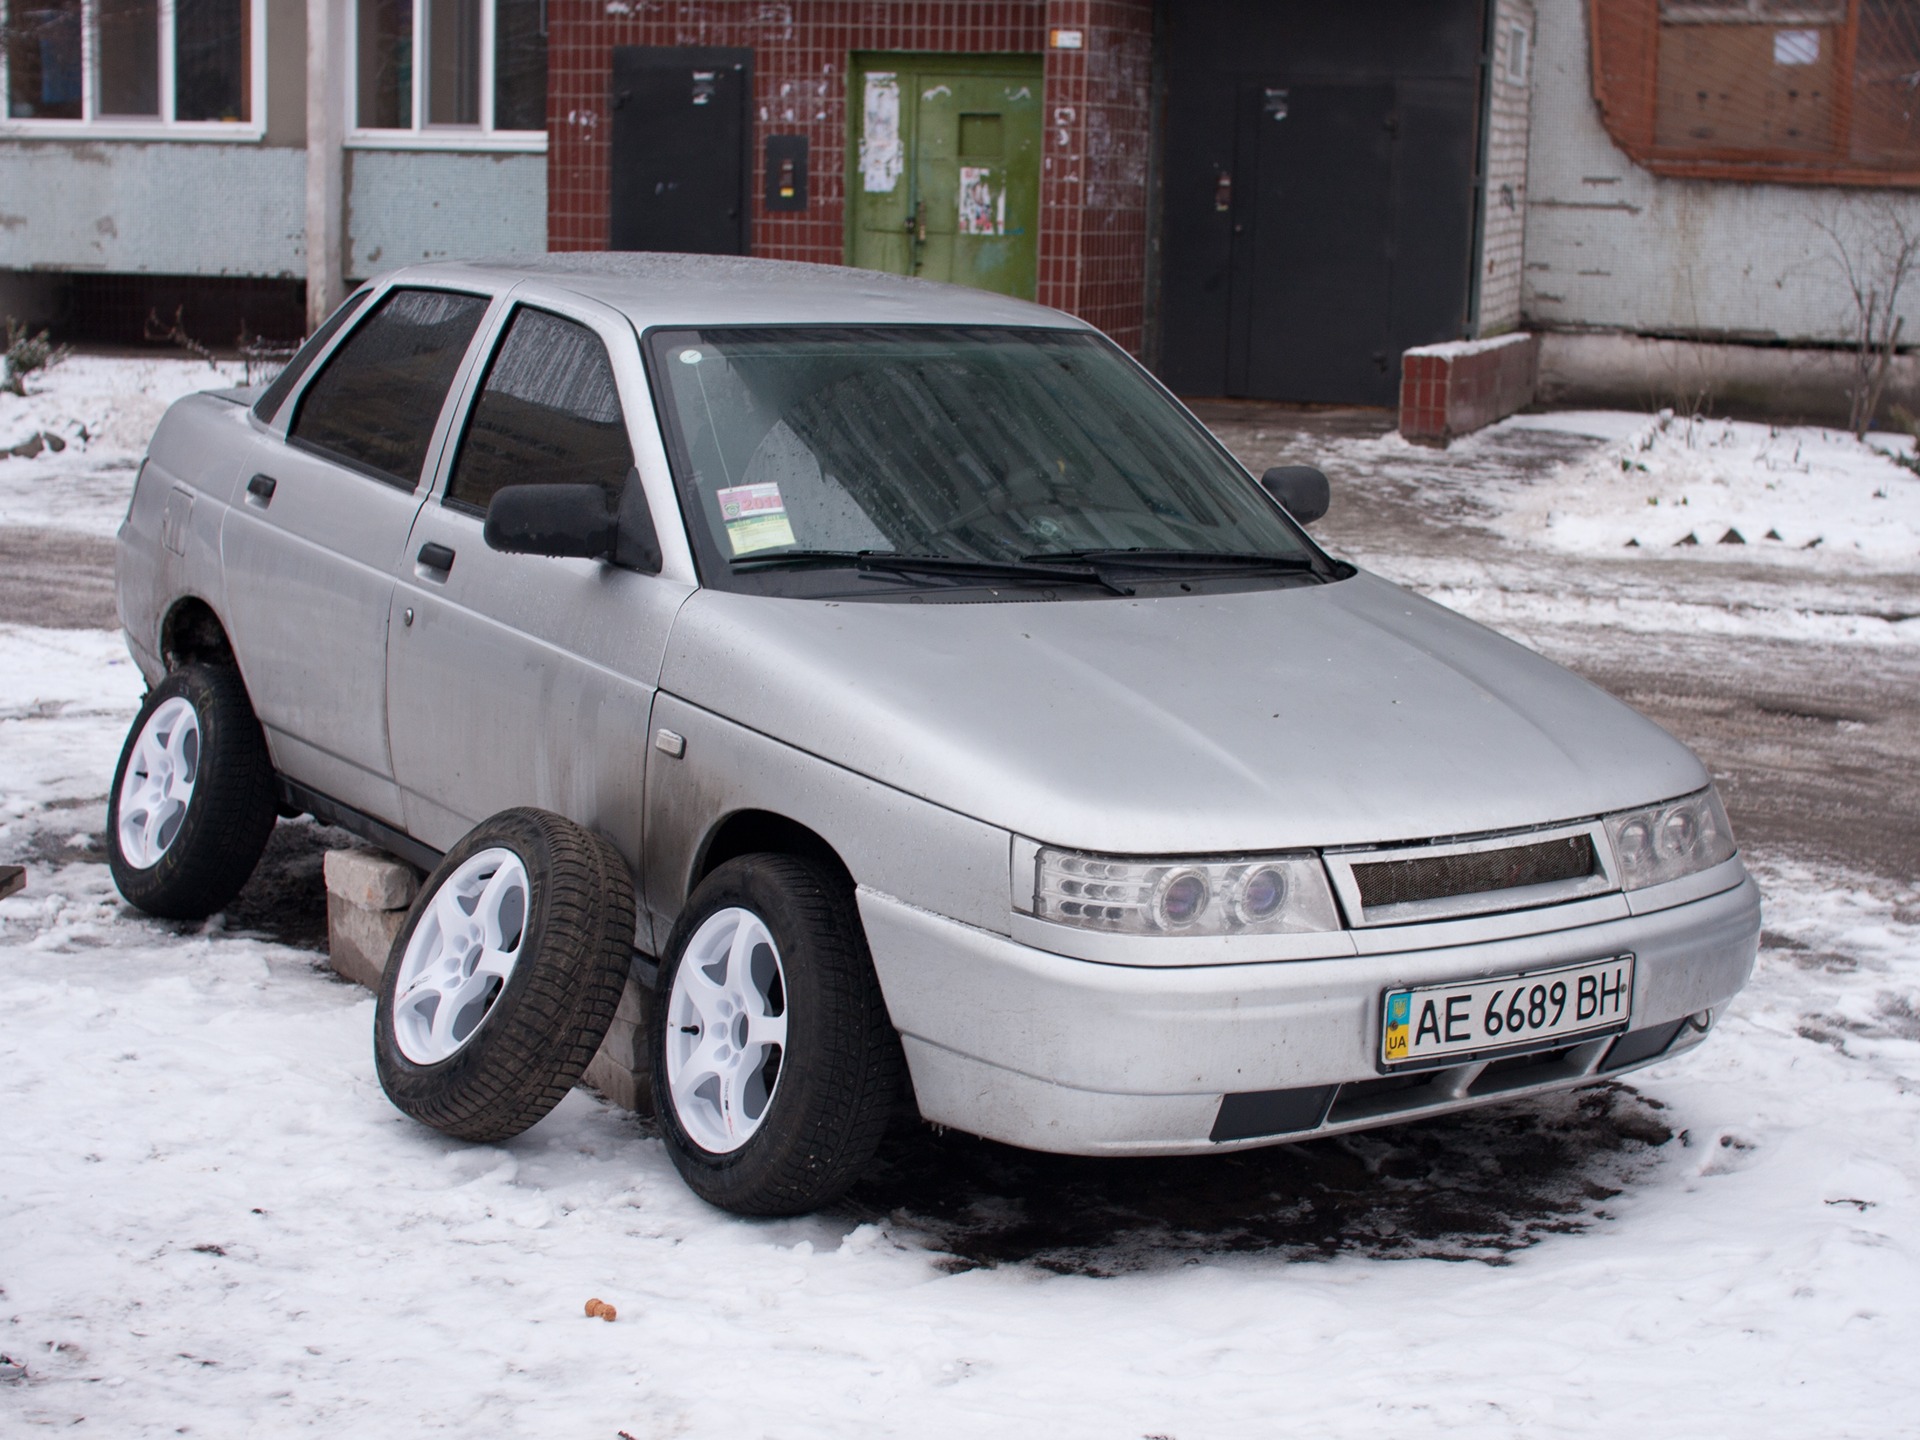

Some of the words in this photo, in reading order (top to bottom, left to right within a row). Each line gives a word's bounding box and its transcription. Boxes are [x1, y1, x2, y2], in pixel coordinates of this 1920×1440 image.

[1415, 994, 1472, 1046] AE
[1484, 981, 1567, 1036] 6689
[1576, 968, 1621, 1021] BH
[1389, 1035, 1406, 1049] UA
